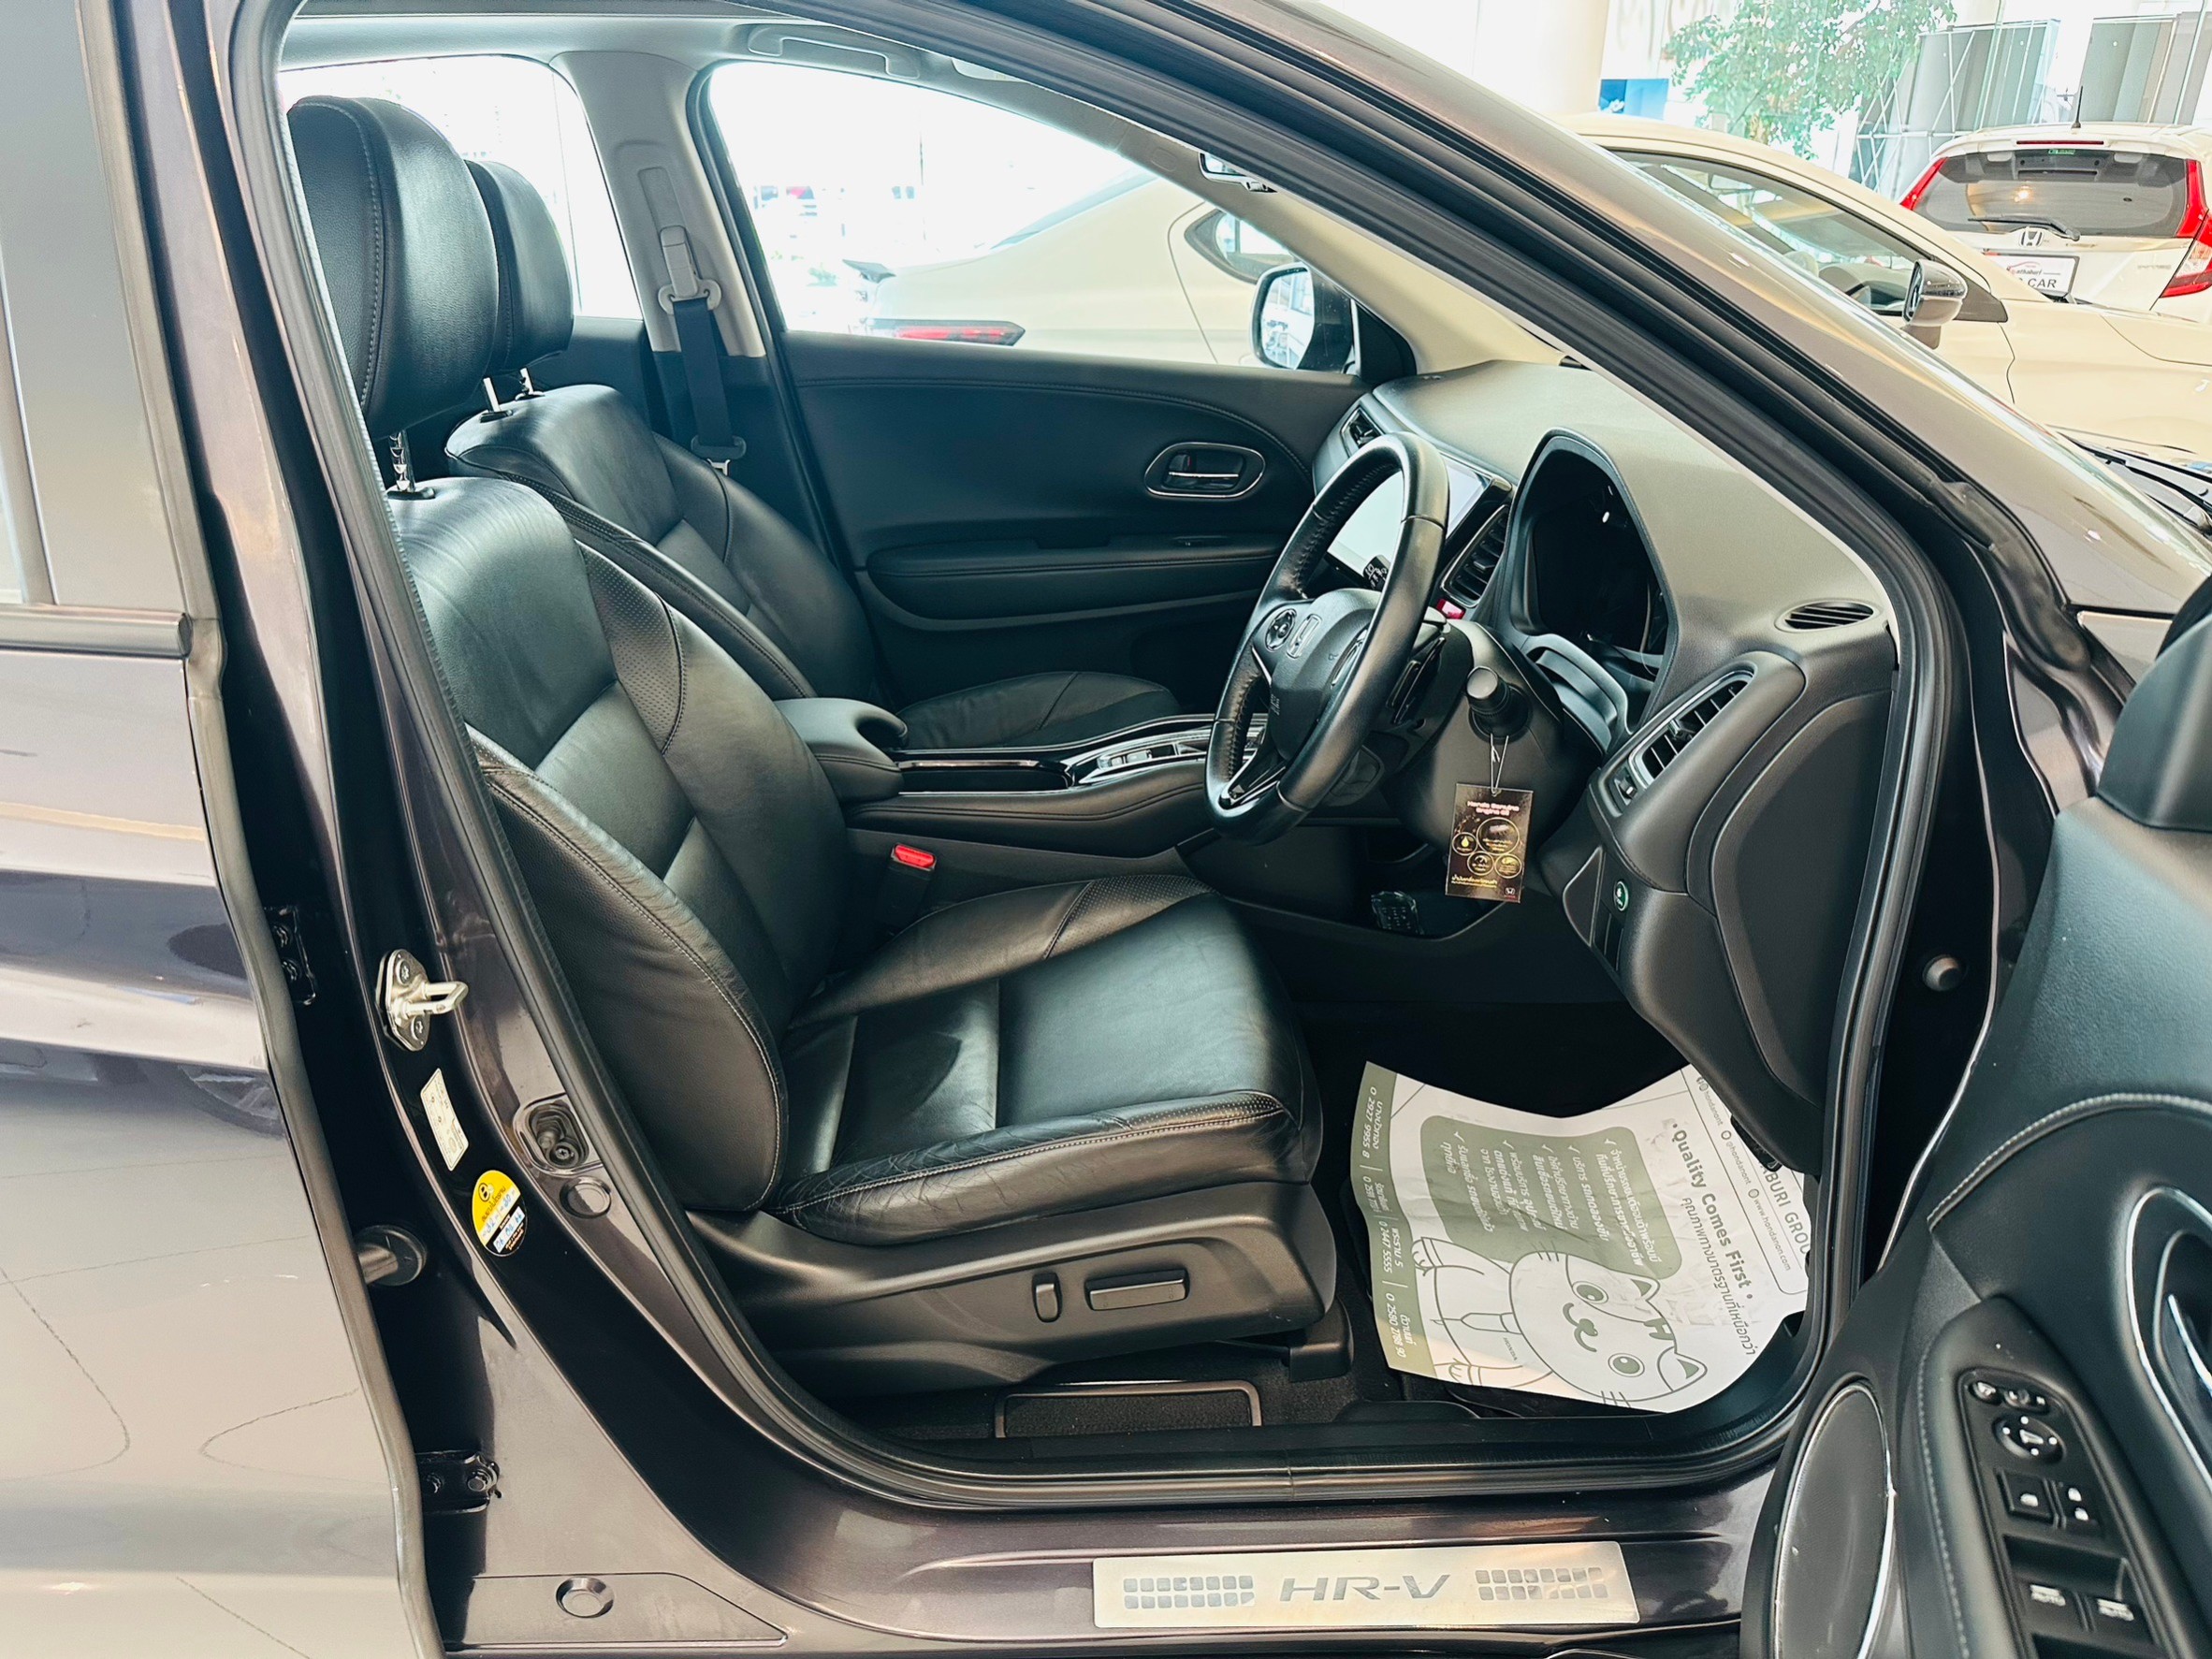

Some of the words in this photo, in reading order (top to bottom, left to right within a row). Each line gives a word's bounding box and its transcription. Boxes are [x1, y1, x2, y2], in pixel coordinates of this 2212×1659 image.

[2027, 277, 2058, 289] CAR
[1365, 1096, 1375, 1123] 2927
[1362, 1124, 1372, 1149] 9955
[1372, 1100, 1384, 1150] บางบัวทอง
[1361, 1149, 1371, 1159] 8
[1480, 1148, 1492, 1165] จาก
[1573, 1156, 1588, 1182] บริการ
[1580, 1183, 1609, 1242] รถทดลองขับ
[1671, 1128, 1707, 1188] Quality
[1700, 1192, 1731, 1249] Comes
[1724, 1248, 1754, 1289] First
[1380, 1228, 1391, 1249] 2447
[1391, 1227, 1401, 1259] พระราม
[1383, 1248, 1393, 1274] 5555
[1394, 1258, 1404, 1269] 5
[1681, 1196, 1757, 1356] คุณภาพทางมาตรฐานที่เหนือกว่า
[1388, 1302, 1398, 1327] 2580
[1279, 1574, 1451, 1602] HR-V
